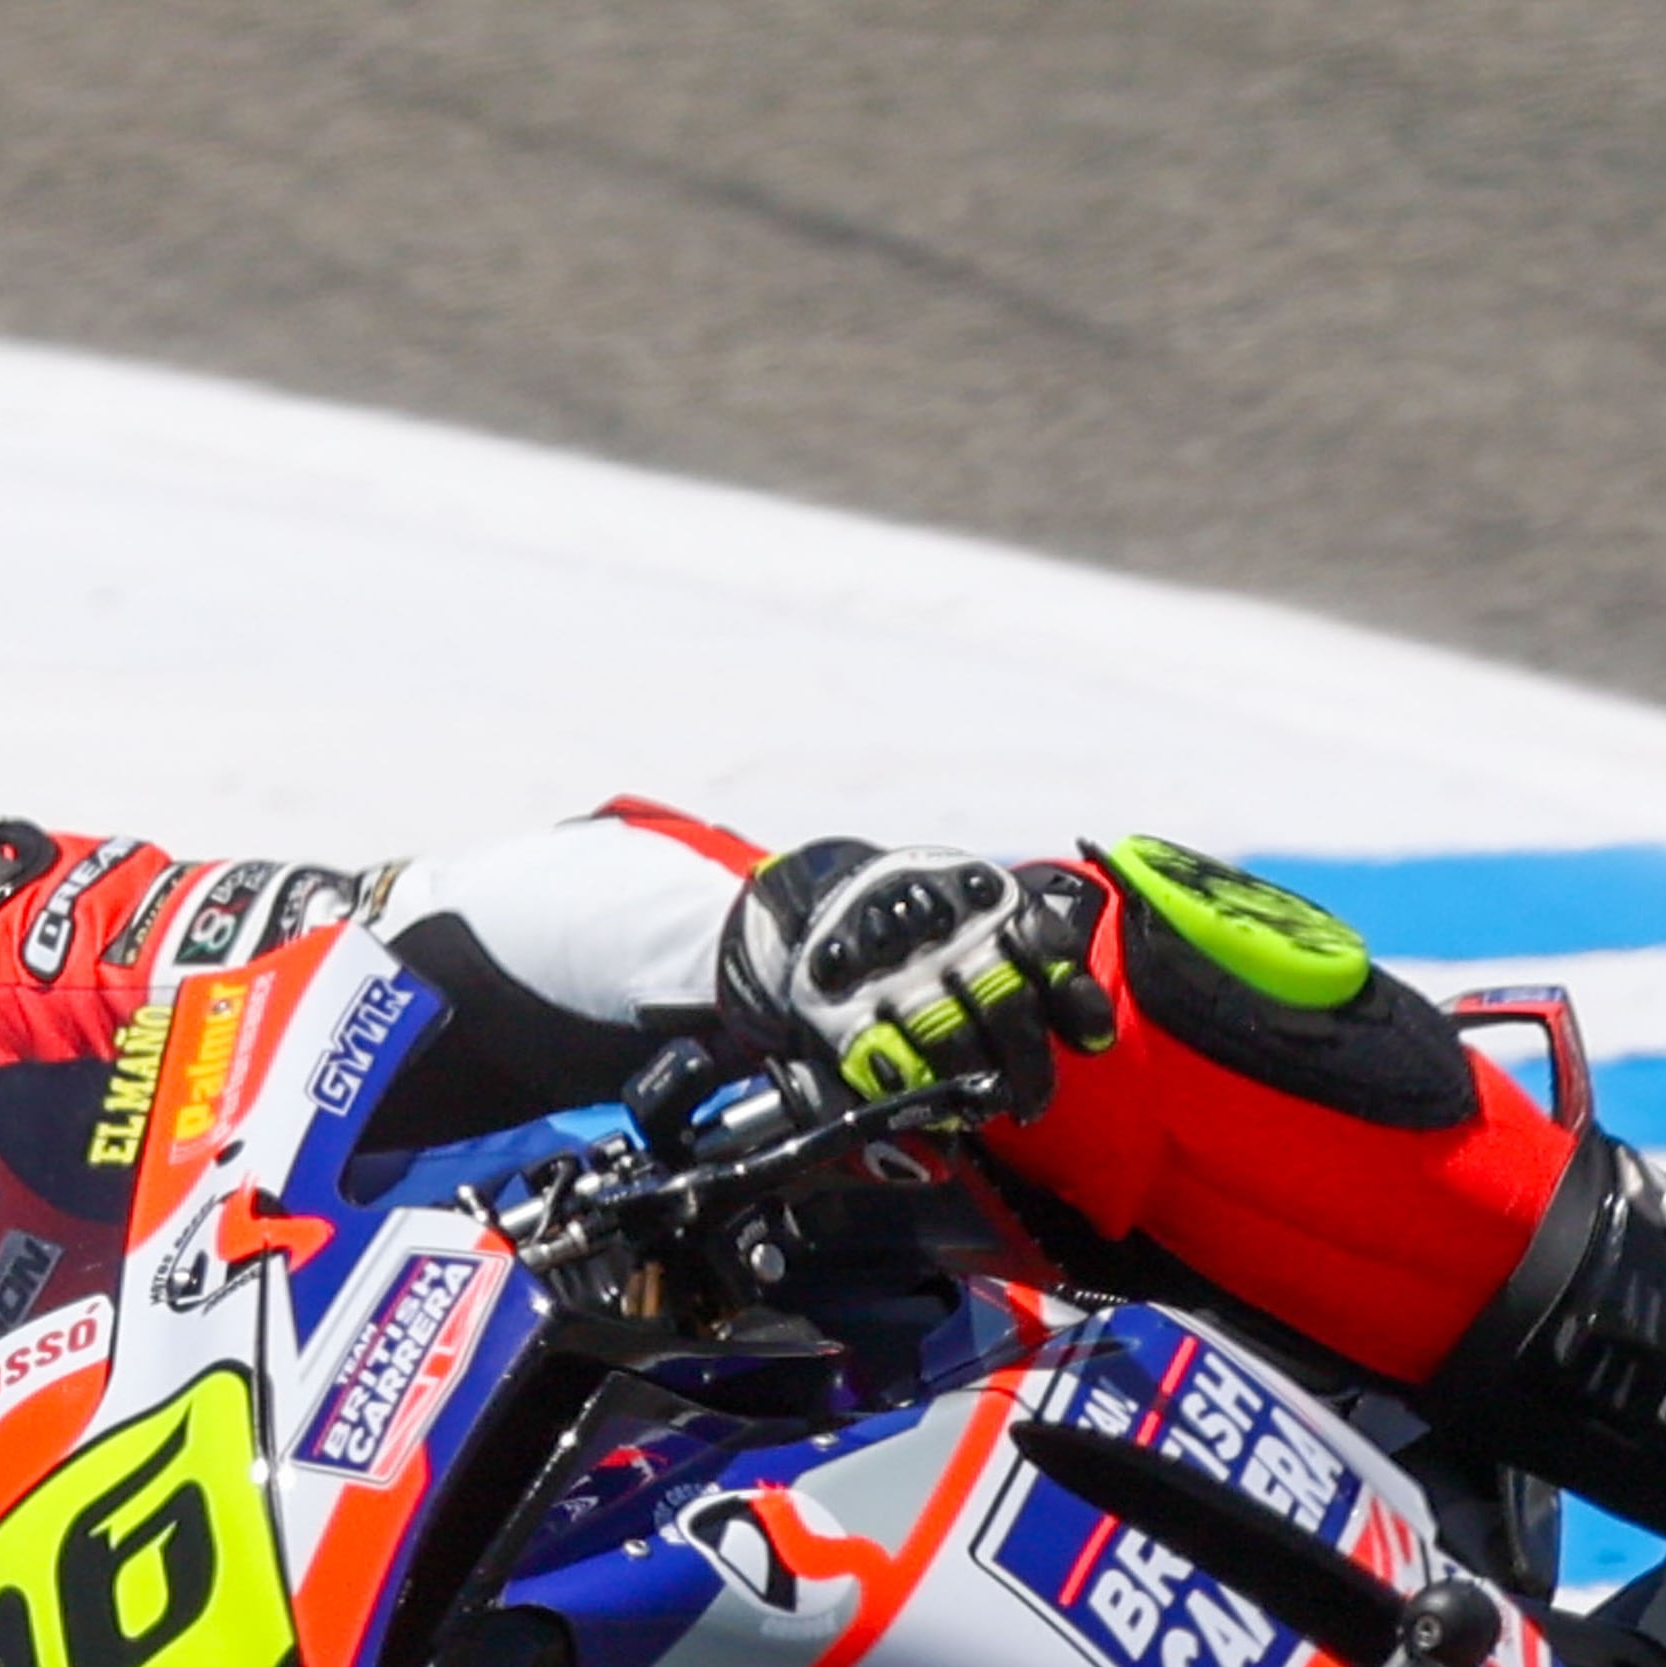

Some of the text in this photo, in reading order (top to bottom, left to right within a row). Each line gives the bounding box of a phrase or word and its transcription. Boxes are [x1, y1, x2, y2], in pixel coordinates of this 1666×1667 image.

[312, 977, 414, 1115] GYTR
[324, 1261, 444, 1460] BRITISH
[347, 1263, 475, 1463] CARRERA
